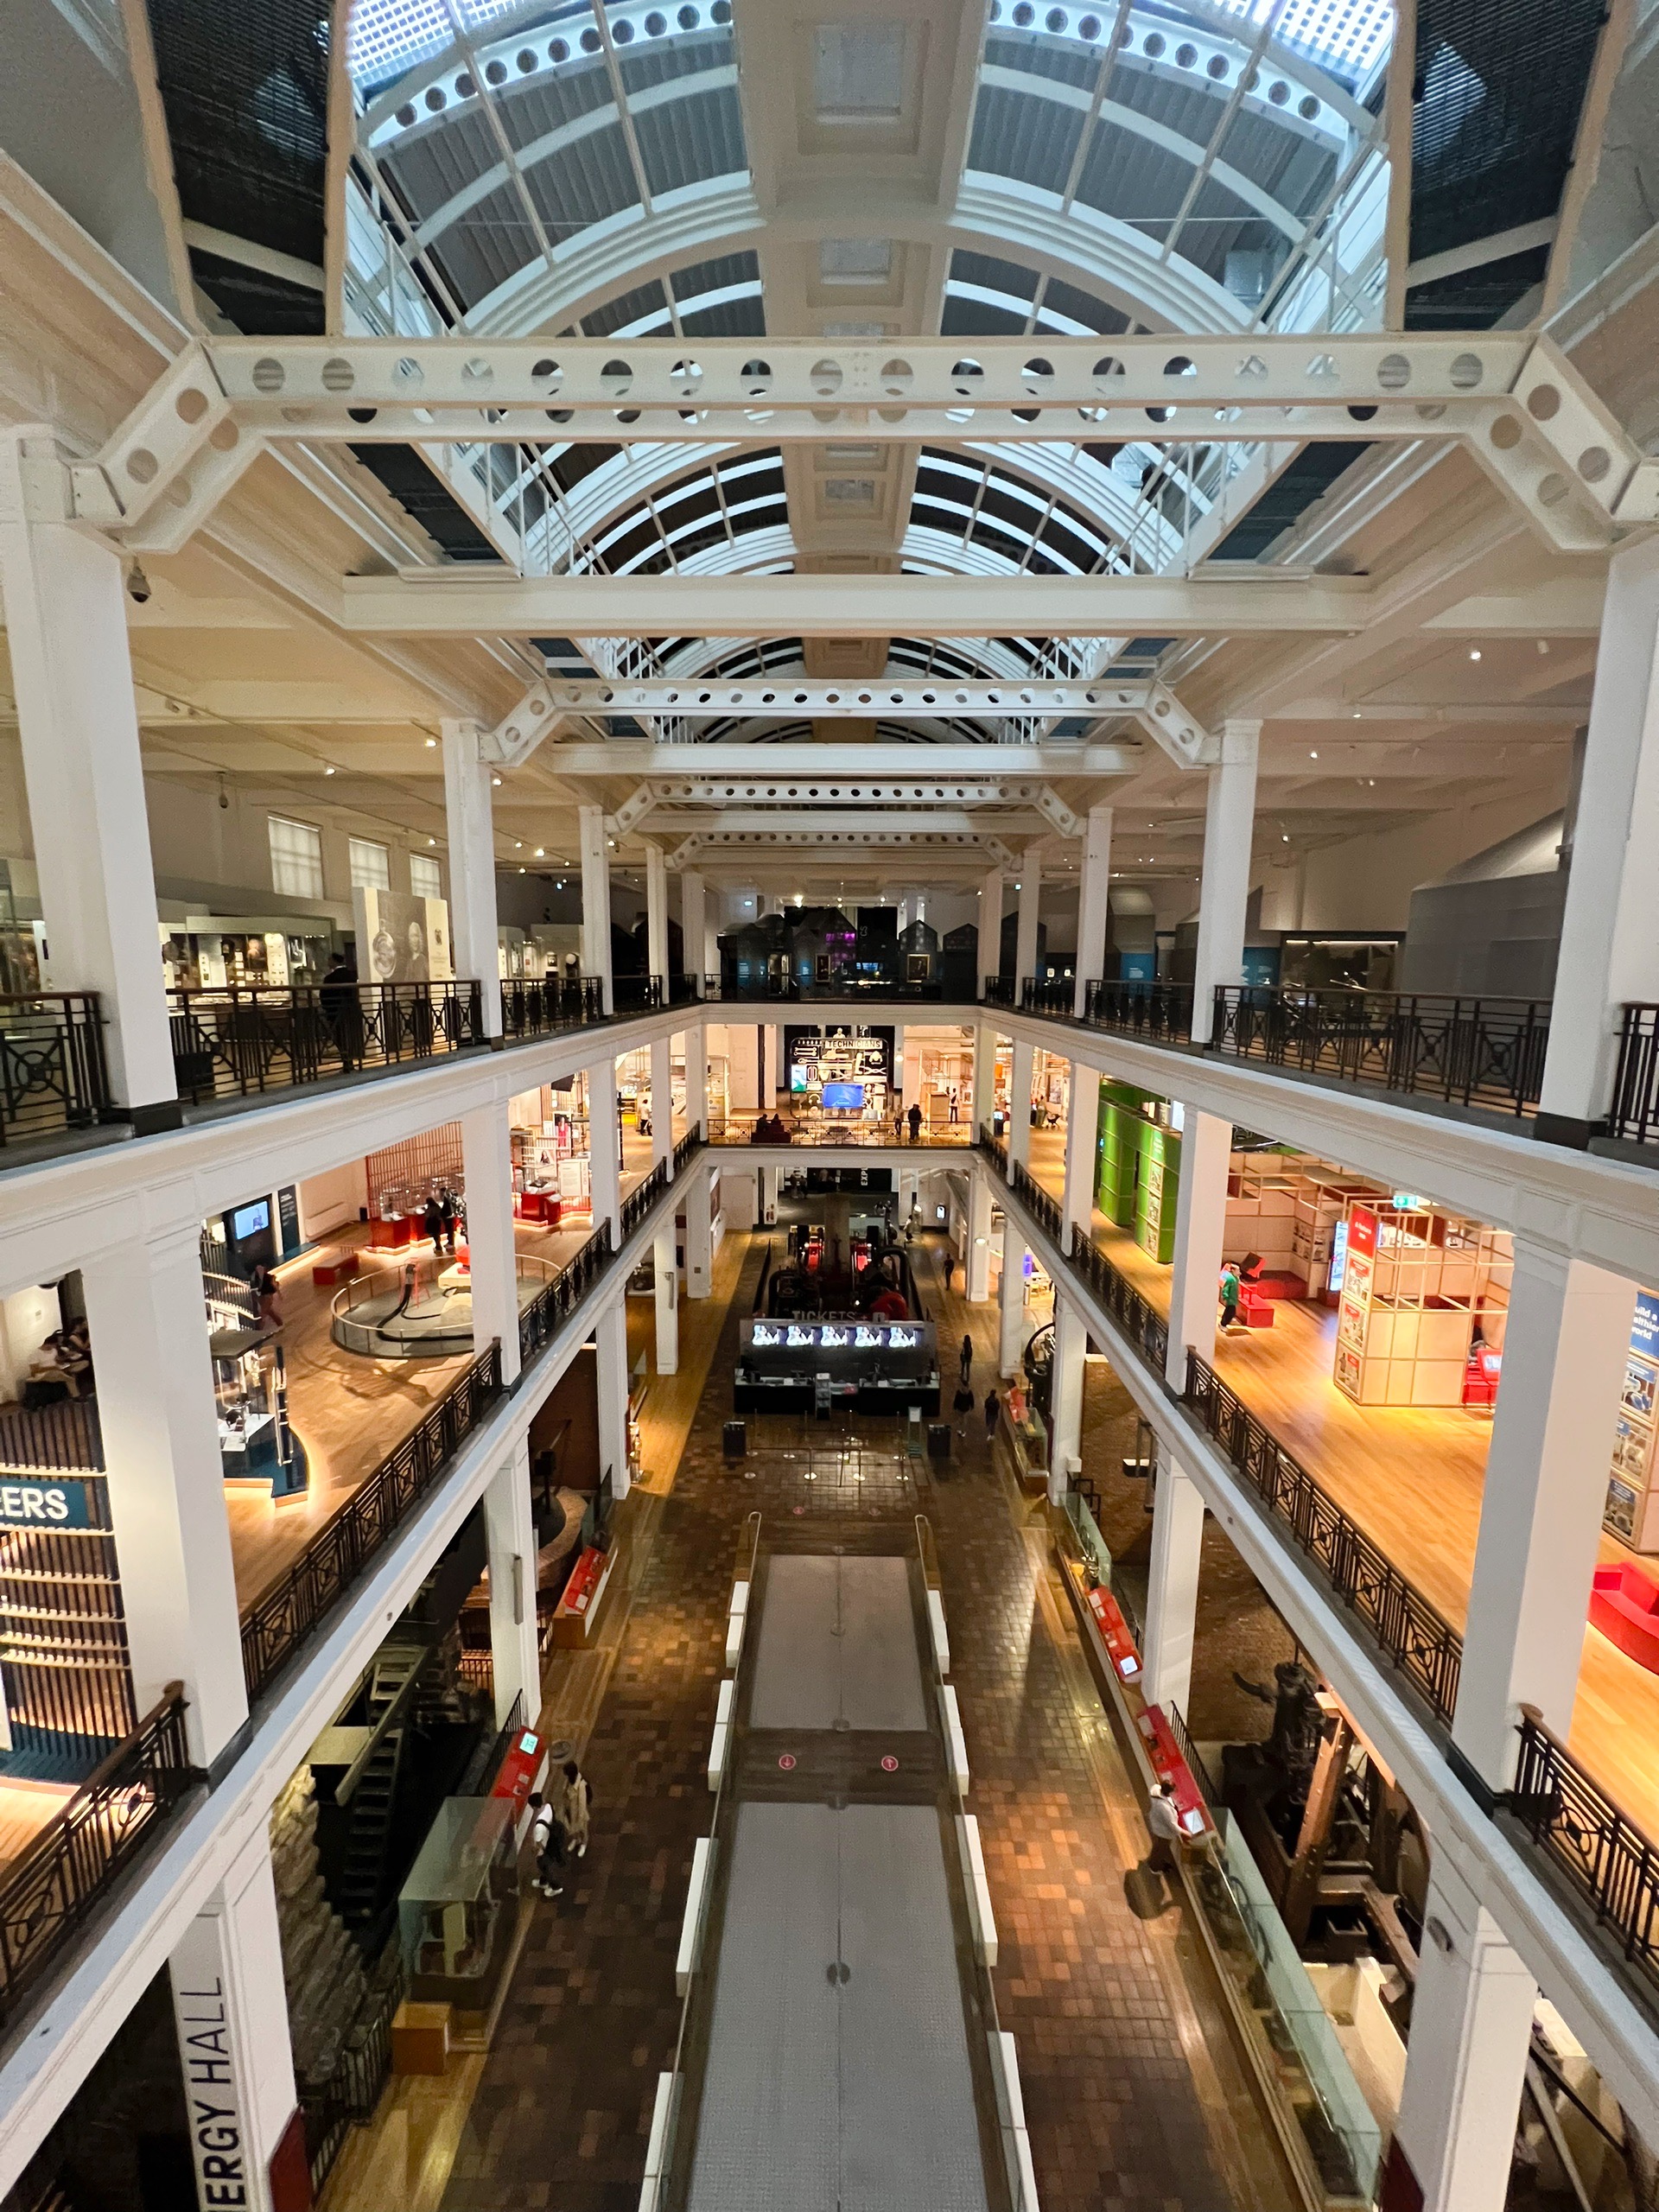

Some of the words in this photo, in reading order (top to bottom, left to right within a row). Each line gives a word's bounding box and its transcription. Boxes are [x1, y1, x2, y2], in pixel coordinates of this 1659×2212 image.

[827, 1039, 880, 1048] TECHNICIANS
[791, 1310, 856, 1321] TICKETS
[0, 1486, 68, 1519] ERS
[180, 1977, 231, 2083] HALL
[194, 2101, 246, 2212] ERGY
